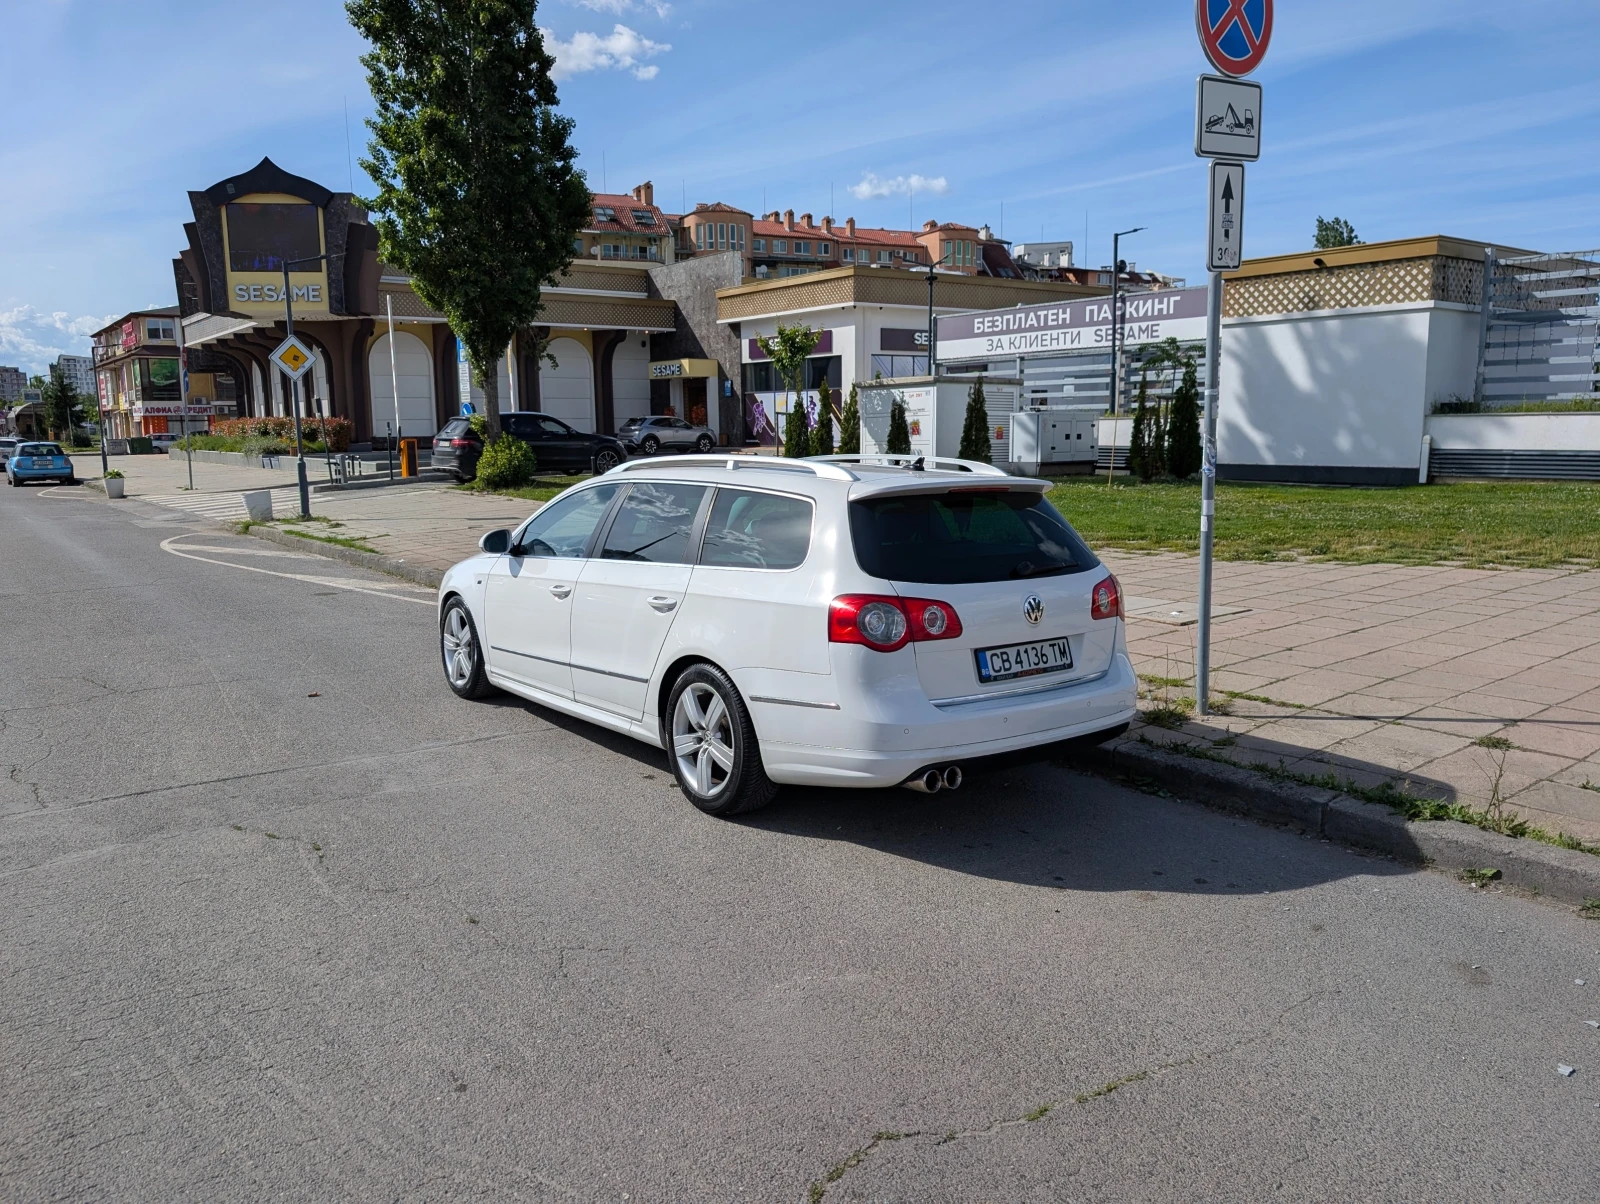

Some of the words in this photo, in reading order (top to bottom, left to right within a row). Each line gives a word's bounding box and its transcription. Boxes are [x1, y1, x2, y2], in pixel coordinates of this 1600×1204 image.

[234, 285, 322, 302] SESAME
[974, 308, 1070, 333] БЕЗПЛАТЕН
[1085, 296, 1181, 322] ПАРКИНГ
[986, 338, 1004, 352] ЗА
[1008, 330, 1081, 351] КЛИЕНТИ
[1094, 323, 1160, 343] SESAME
[652, 363, 681, 376] SESAME
[144, 406, 172, 414] АЛФИА
[1015, 645, 1048, 669] 4136
